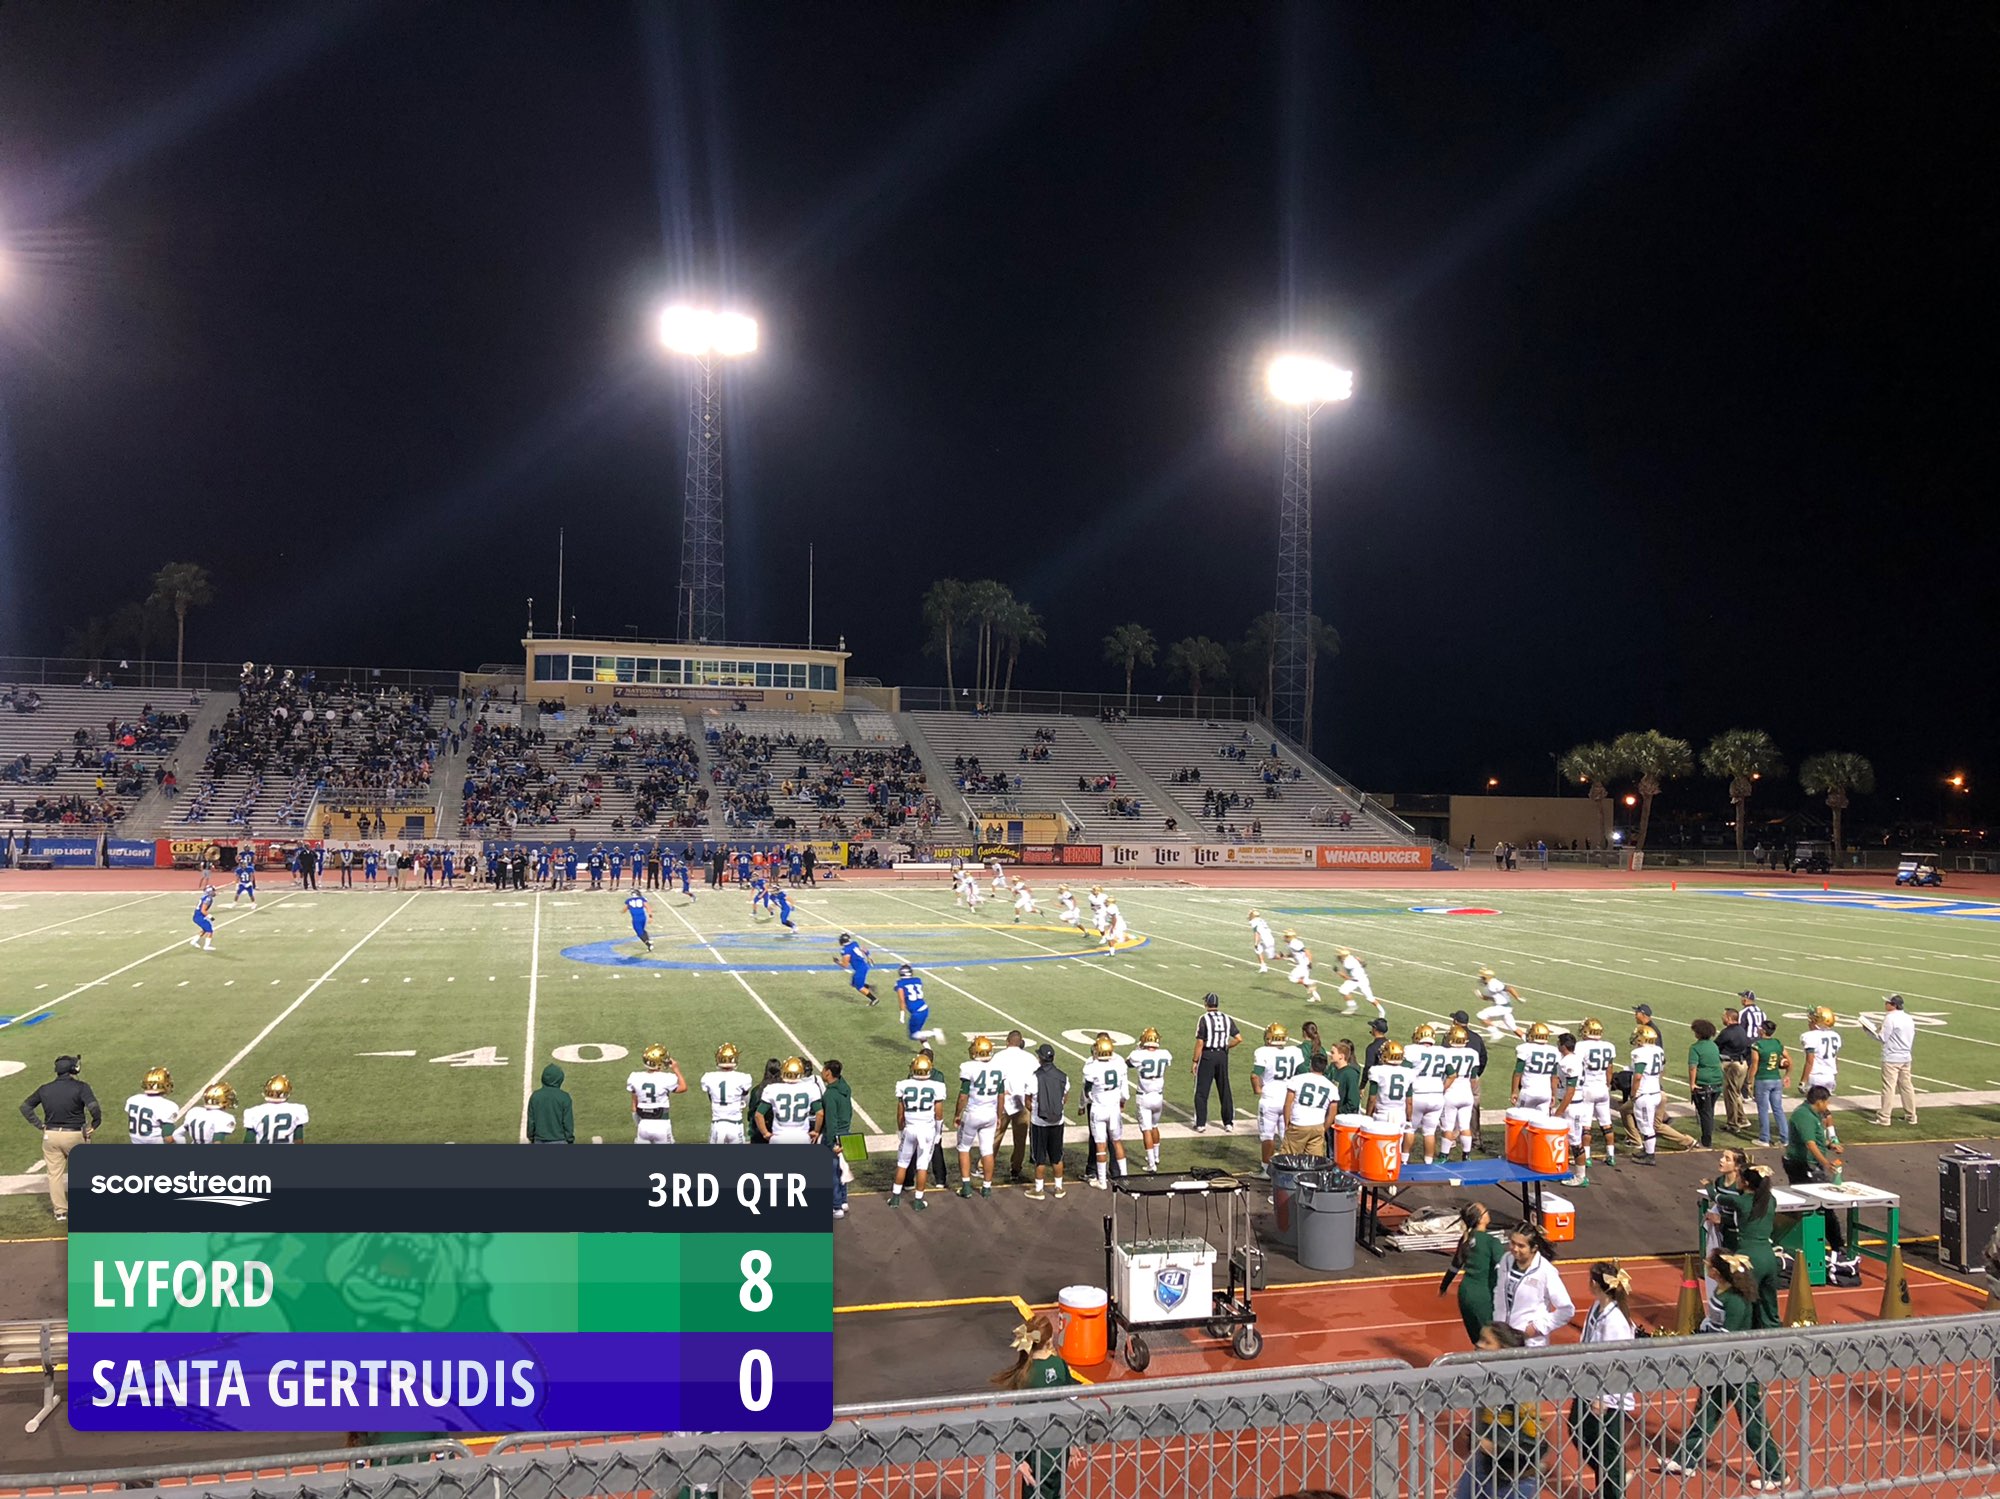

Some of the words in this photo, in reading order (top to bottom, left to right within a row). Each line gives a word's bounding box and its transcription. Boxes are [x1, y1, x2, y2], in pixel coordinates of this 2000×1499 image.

[124, 848, 151, 857] LIGHT
[934, 848, 953, 858] JUST
[1113, 846, 1139, 865] Lite
[1155, 847, 1180, 865] Lite
[1194, 847, 1219, 865] Lite
[1325, 850, 1421, 864] WHATABURGER
[1588, 1047, 1612, 1071] 58
[1821, 1037, 1838, 1060] 75
[1274, 1056, 1295, 1080] 51
[1419, 1054, 1445, 1078] 72
[1451, 1055, 1475, 1079] 77
[1530, 1051, 1556, 1075] 52
[974, 1070, 1003, 1096] 43
[1103, 1069, 1118, 1092] 9
[1388, 1073, 1404, 1101] 6
[641, 1082, 656, 1104] 3
[718, 1080, 727, 1106] 1
[904, 1086, 936, 1112] 22
[1300, 1083, 1330, 1109] 67
[775, 1092, 809, 1122] 32
[260, 1112, 293, 1144] 12
